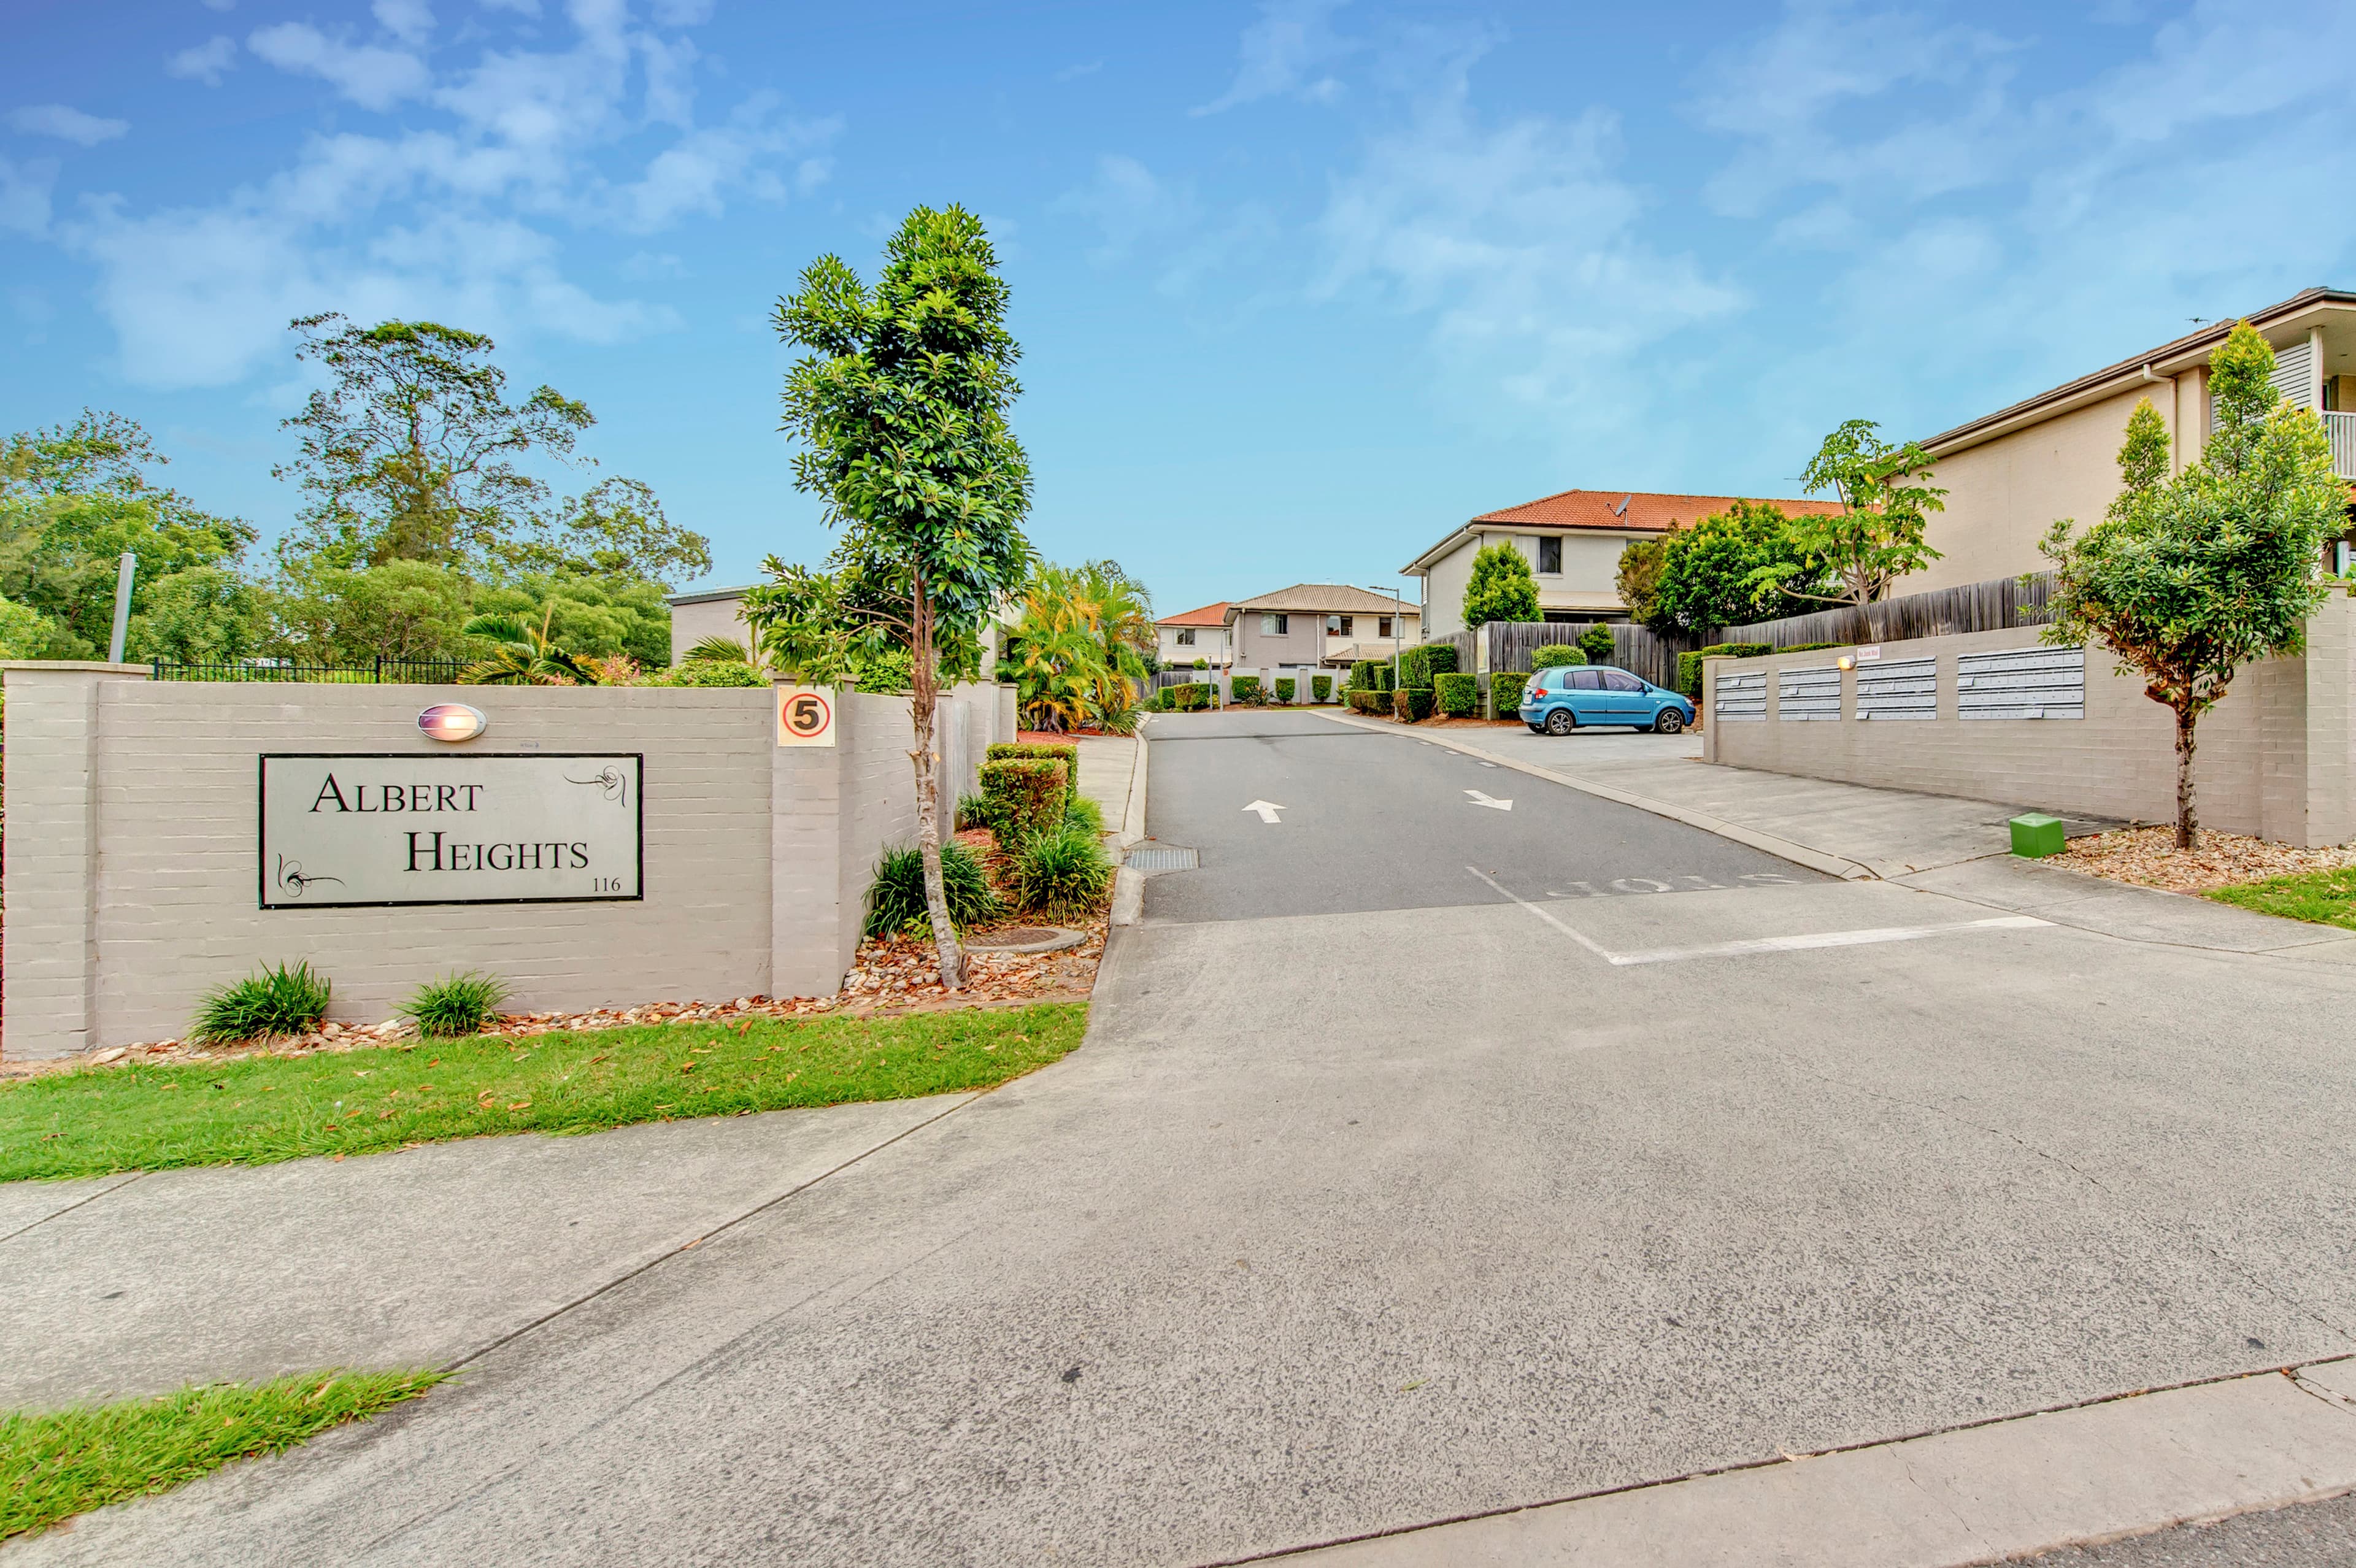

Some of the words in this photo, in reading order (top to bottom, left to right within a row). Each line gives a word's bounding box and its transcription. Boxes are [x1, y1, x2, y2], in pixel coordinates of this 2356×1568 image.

[793, 700, 819, 730] 5
[307, 772, 483, 813] ALBERT
[403, 831, 589, 872] HEIGHTS
[593, 877, 620, 893] 116
[1546, 874, 1803, 897] STOP
